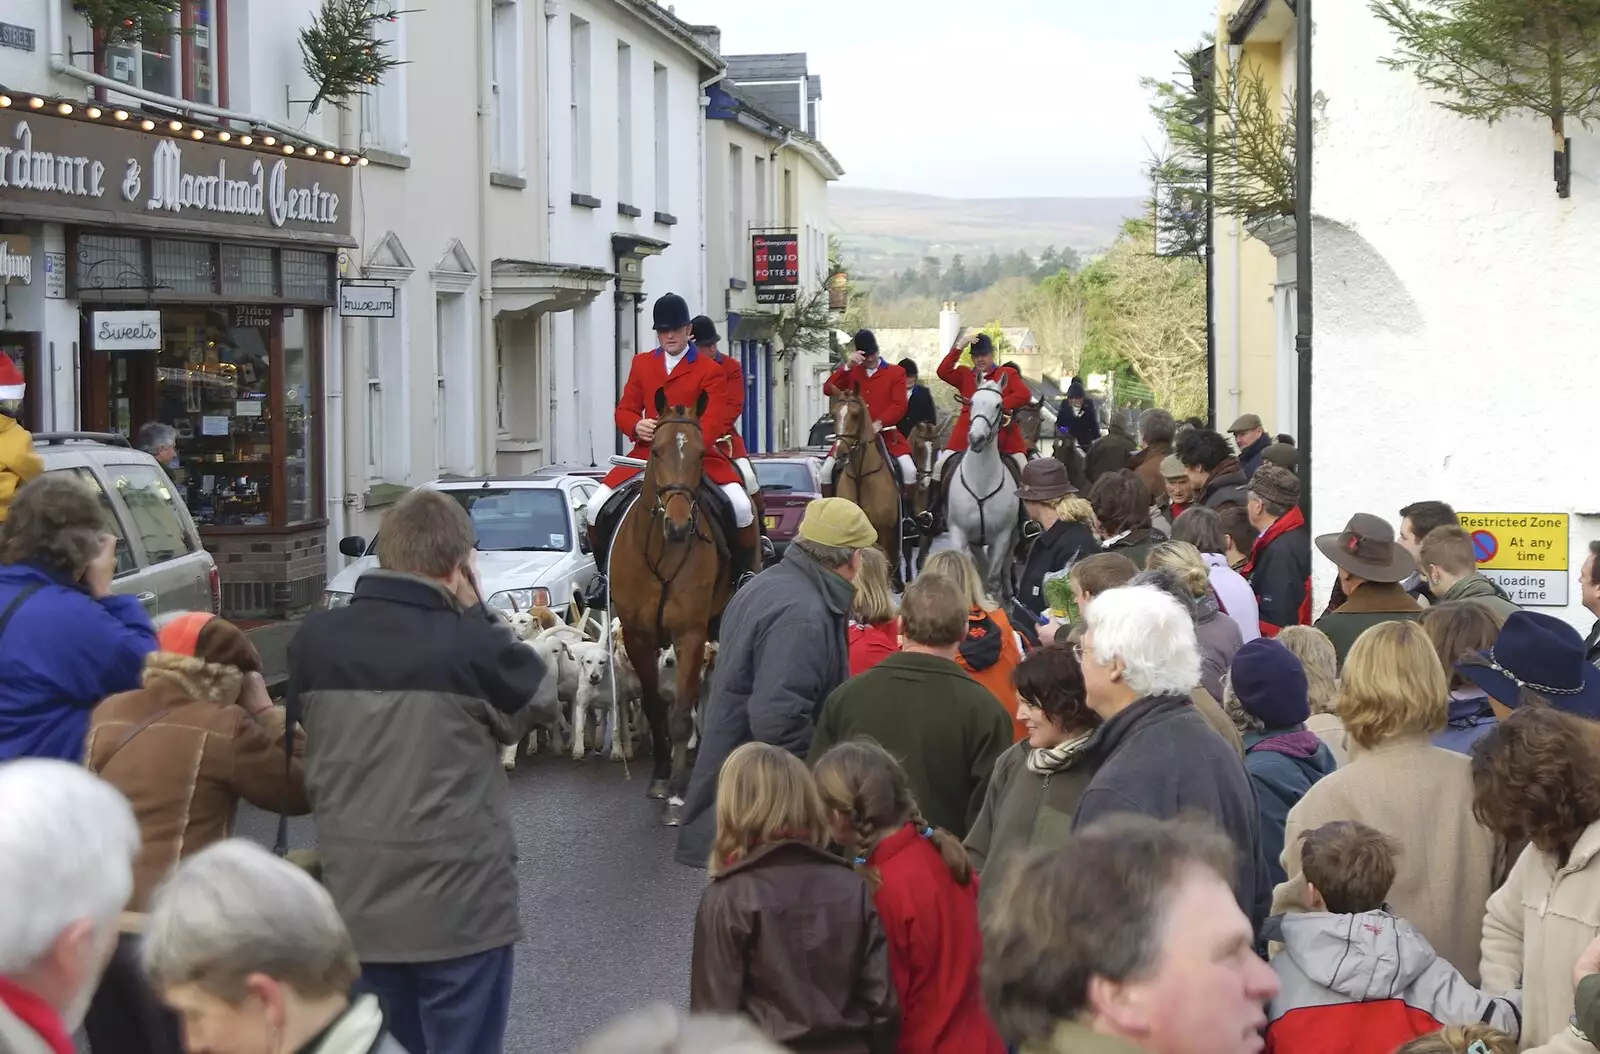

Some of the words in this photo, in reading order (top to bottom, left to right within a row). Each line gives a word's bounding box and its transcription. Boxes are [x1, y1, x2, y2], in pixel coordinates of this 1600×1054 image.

[3, 25, 35, 47] STREET
[122, 157, 142, 202] &
[147, 139, 265, 215] Moorland
[269, 157, 340, 228] Centre
[756, 254, 798, 262] STUDIO
[756, 269, 798, 277] POTTERY
[342, 294, 392, 311] museum
[235, 304, 272, 316] Video
[235, 316, 271, 328] Films
[98, 320, 157, 340] Sweets
[1460, 516, 1527, 528] Restricted
[1530, 516, 1562, 528] Zone
[1510, 537, 1525, 548] At
[1530, 539, 1553, 550] any
[1517, 551, 1545, 561] time
[1499, 575, 1546, 588] loading
[1518, 589, 1547, 600] time
